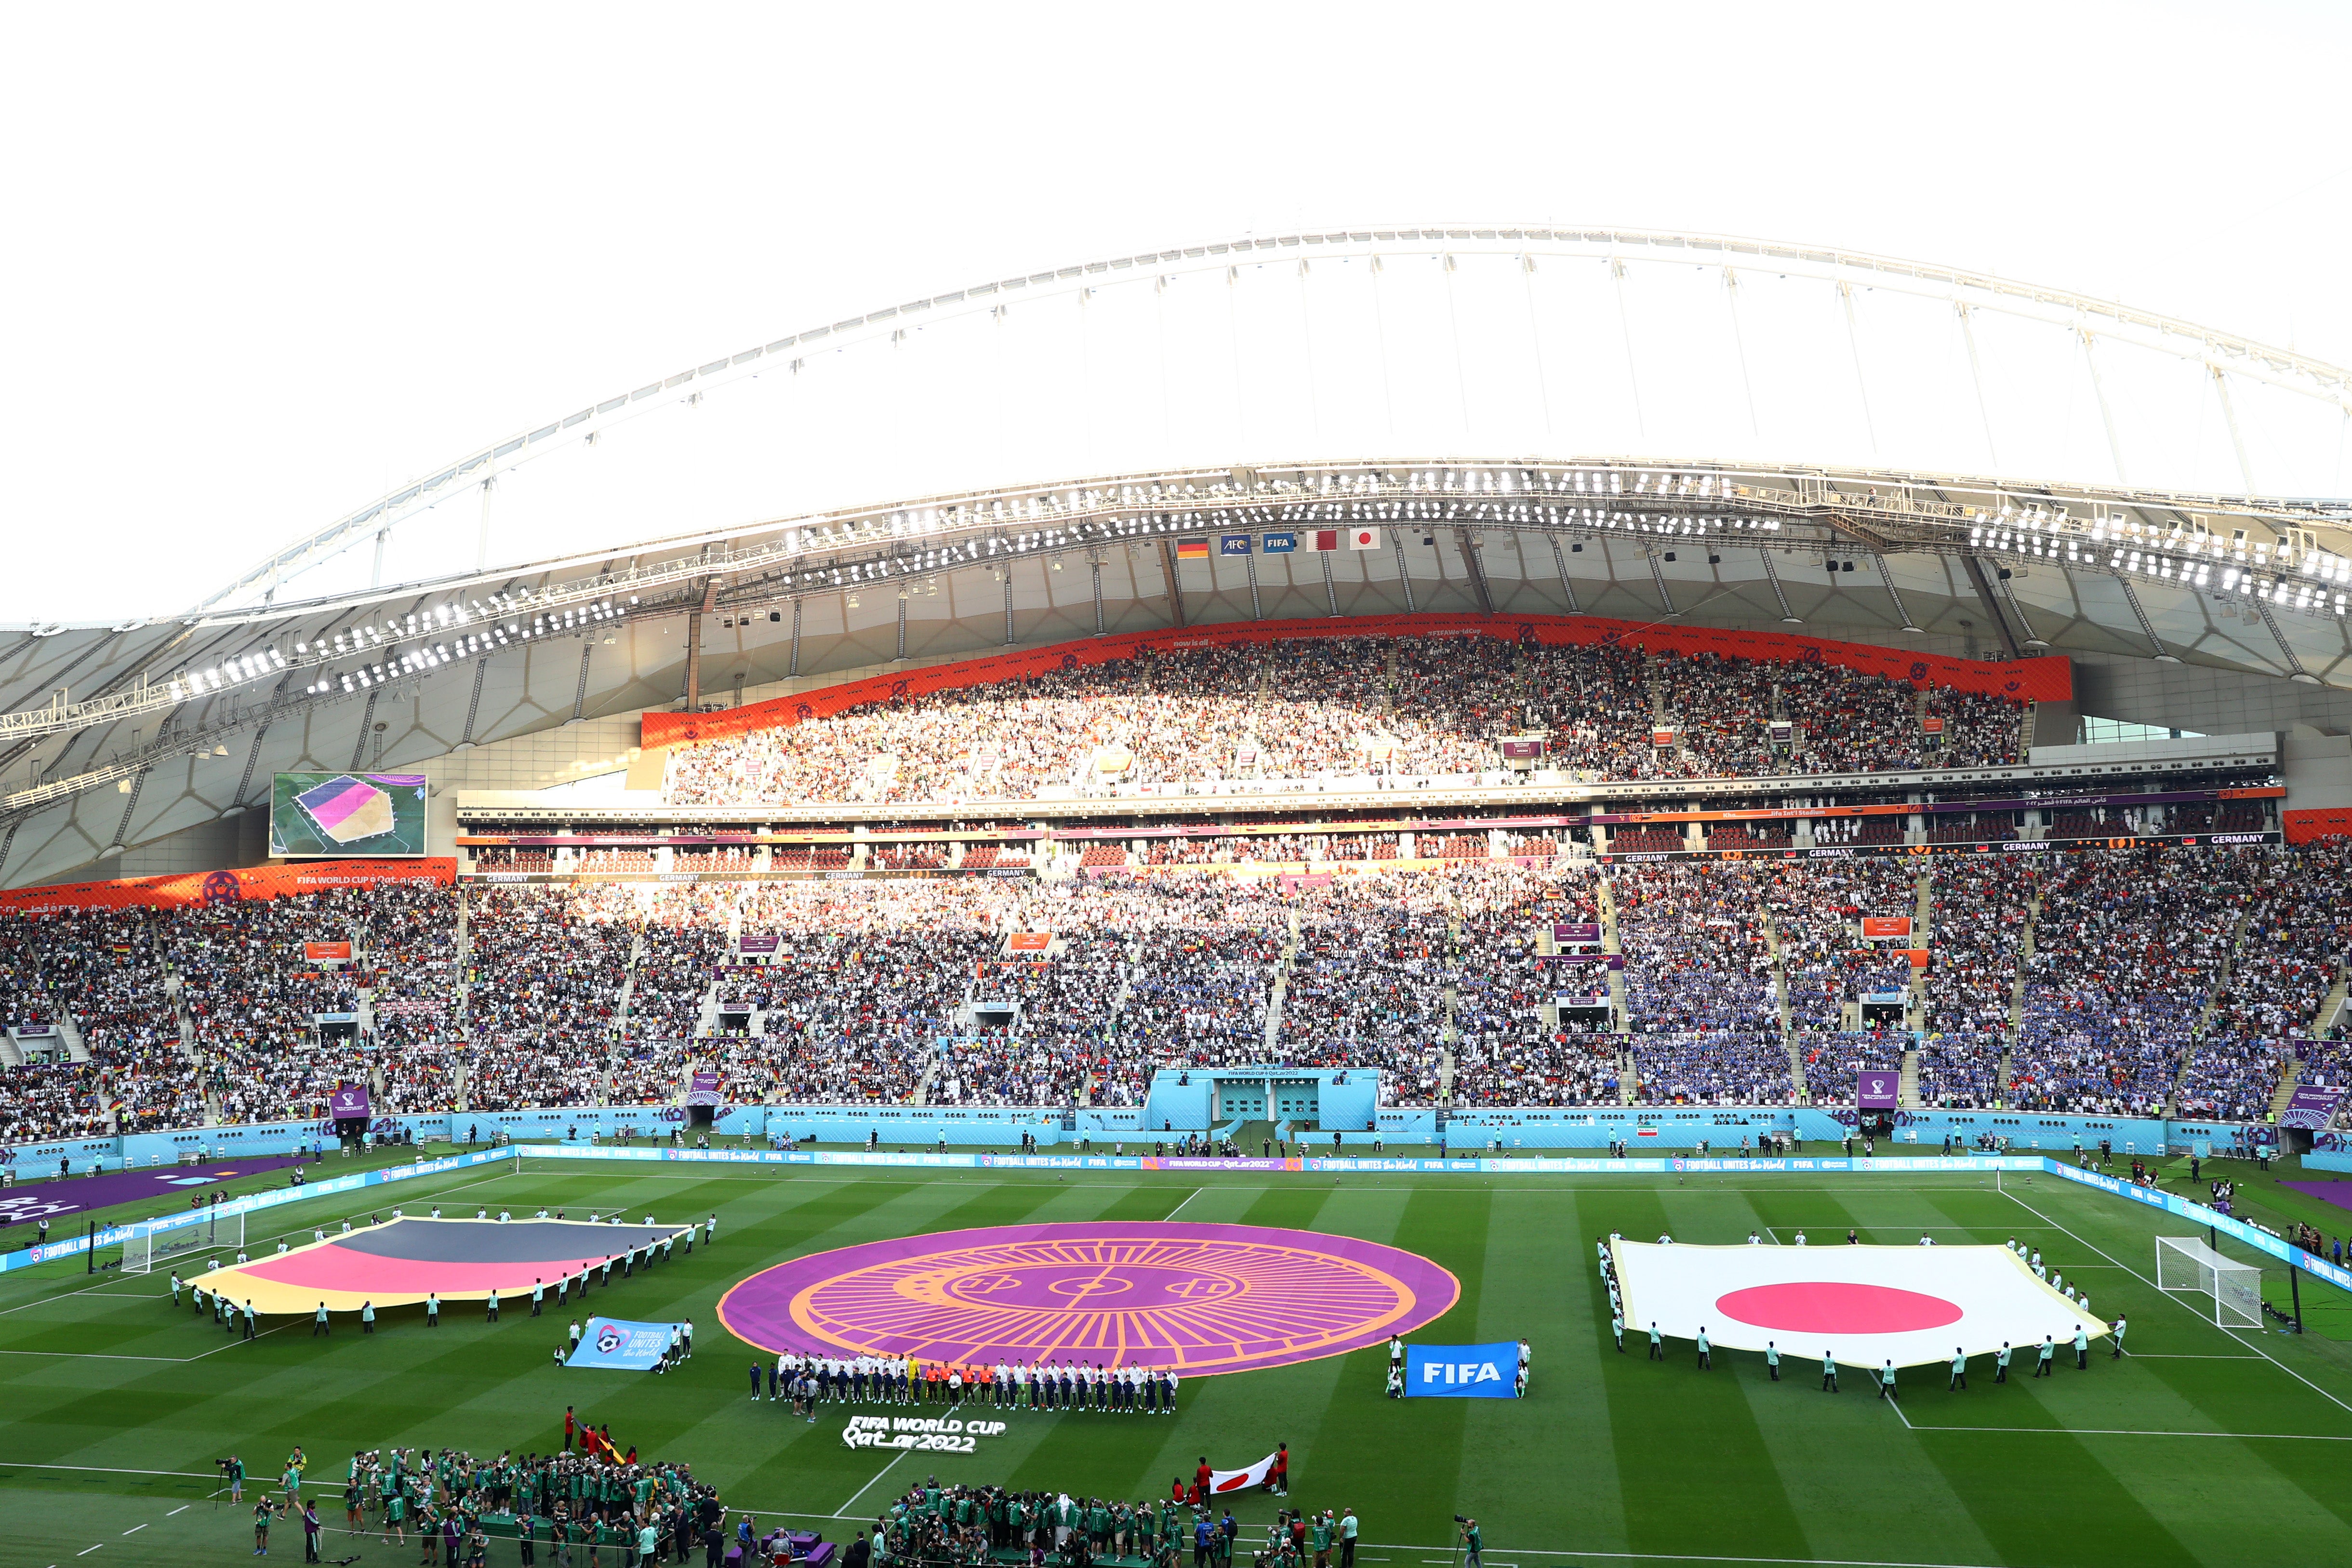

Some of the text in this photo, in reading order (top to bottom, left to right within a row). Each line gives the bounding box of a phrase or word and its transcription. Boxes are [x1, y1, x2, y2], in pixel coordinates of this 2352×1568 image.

[1268, 539, 1289, 547] FIFA
[2211, 835, 2264, 843] GERMANY
[532, 1147, 563, 1156] FOOTBALL
[591, 1148, 609, 1156] World
[730, 1152, 740, 1160] the
[740, 1152, 759, 1161] World
[472, 1154, 486, 1162] FIFA
[833, 1155, 917, 1164] FOOTBALL UNITES the World
[994, 1157, 1081, 1167] FOOTBALL UNITES the World
[391, 1158, 458, 1179] FOOTBALL UNITES the World
[1323, 1160, 1417, 1170] FOOTBALL UNITES the World
[1502, 1160, 1599, 1170] FOOTBALL UNITES the World
[1687, 1159, 1785, 1170] FOOTBALL UNITES the World
[1875, 1158, 1977, 1169] FOOTBALL UNITES the World
[2062, 1166, 2084, 1181] FOOTBALL
[2084, 1172, 2100, 1185] UNITES
[2105, 1177, 2120, 1193] World
[318, 1183, 332, 1192] FIFA
[257, 1193, 276, 1206] UNITES
[276, 1192, 286, 1202] the
[286, 1188, 302, 1200] World
[2131, 1188, 2143, 1198] FIFA
[44, 1243, 78, 1258] FOOTBALL
[103, 1232, 115, 1244] the
[115, 1228, 134, 1241] World
[2311, 1258, 2351, 1288] FOOTBALL UNITES
[628, 1338, 664, 1348] UNITES
[635, 1348, 660, 1357] World
[1424, 1362, 1502, 1383] FIFA
[848, 1416, 1006, 1435] FIFA WORLD CUP
